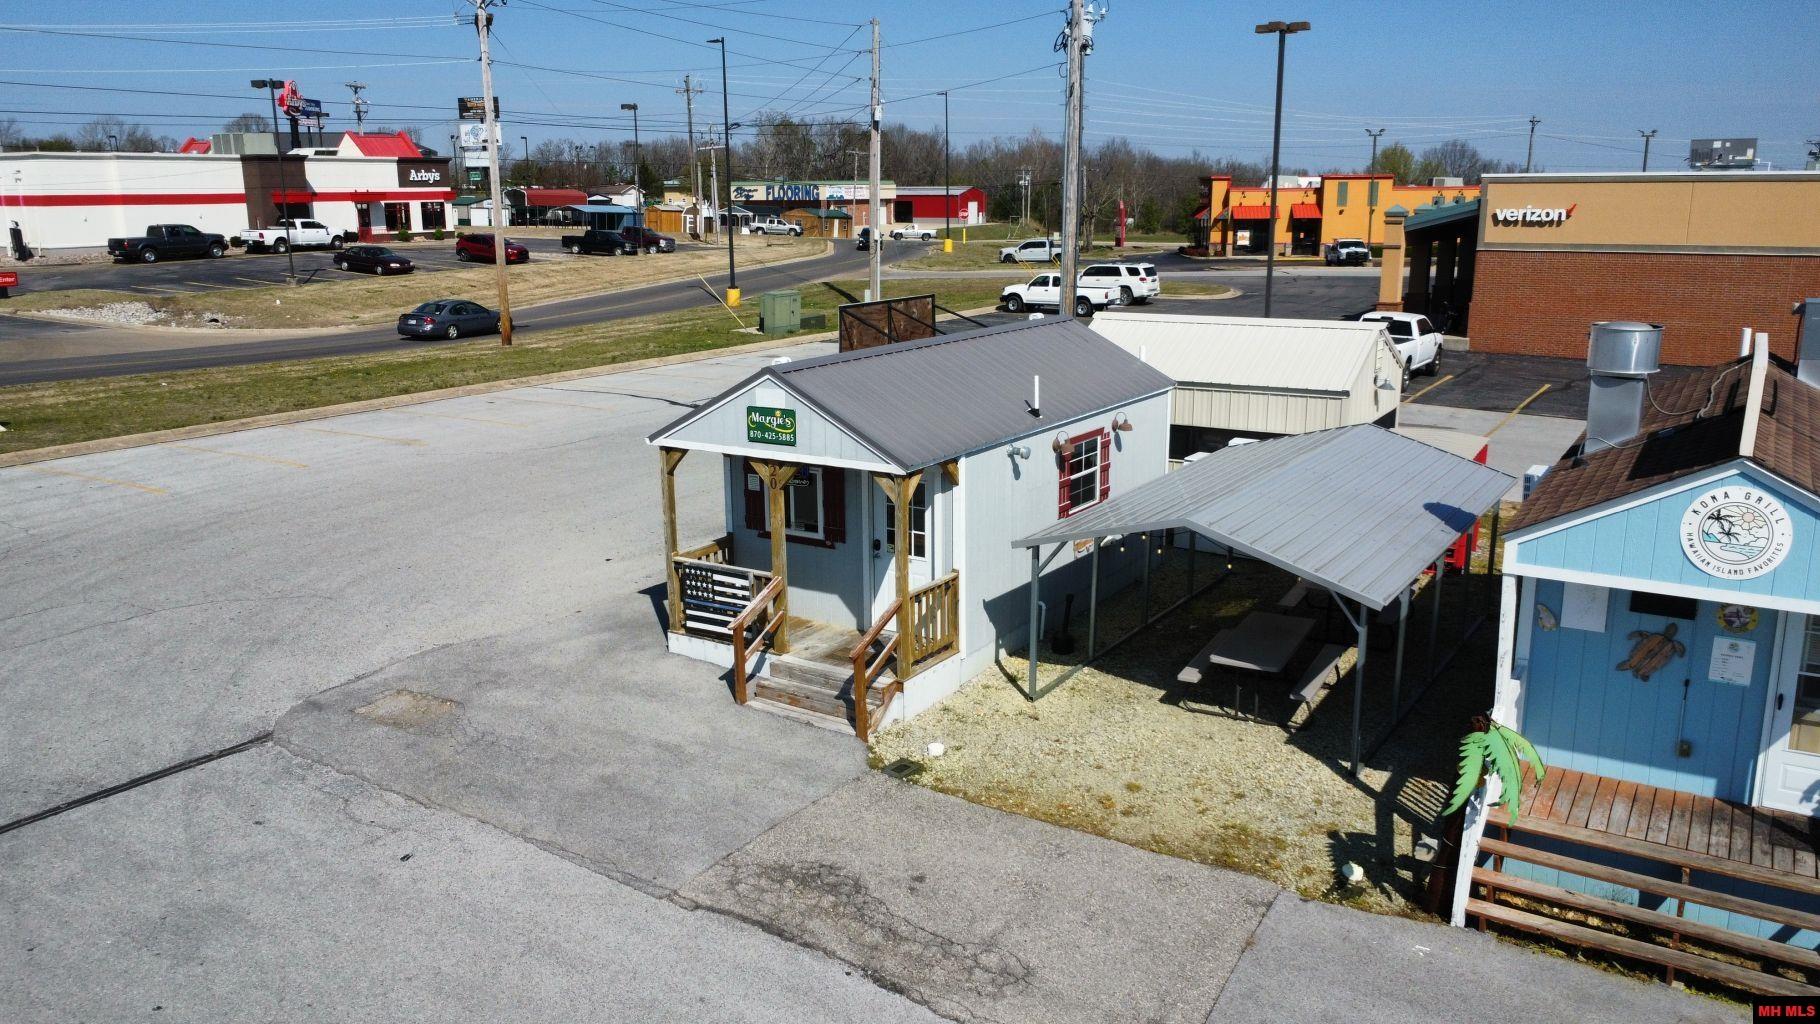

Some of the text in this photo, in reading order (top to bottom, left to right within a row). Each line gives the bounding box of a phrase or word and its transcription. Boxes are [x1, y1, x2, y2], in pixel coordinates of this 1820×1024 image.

[410, 169, 441, 184] Arby's
[765, 185, 820, 200] FLOORING
[1495, 205, 1567, 221] verizon
[751, 411, 792, 429] Margie's
[749, 430, 795, 442] 870-425-5885
[1691, 491, 1785, 525] KONA GRILL
[1686, 532, 1784, 576] HAWAIIAN ISLAND FAVORITES
